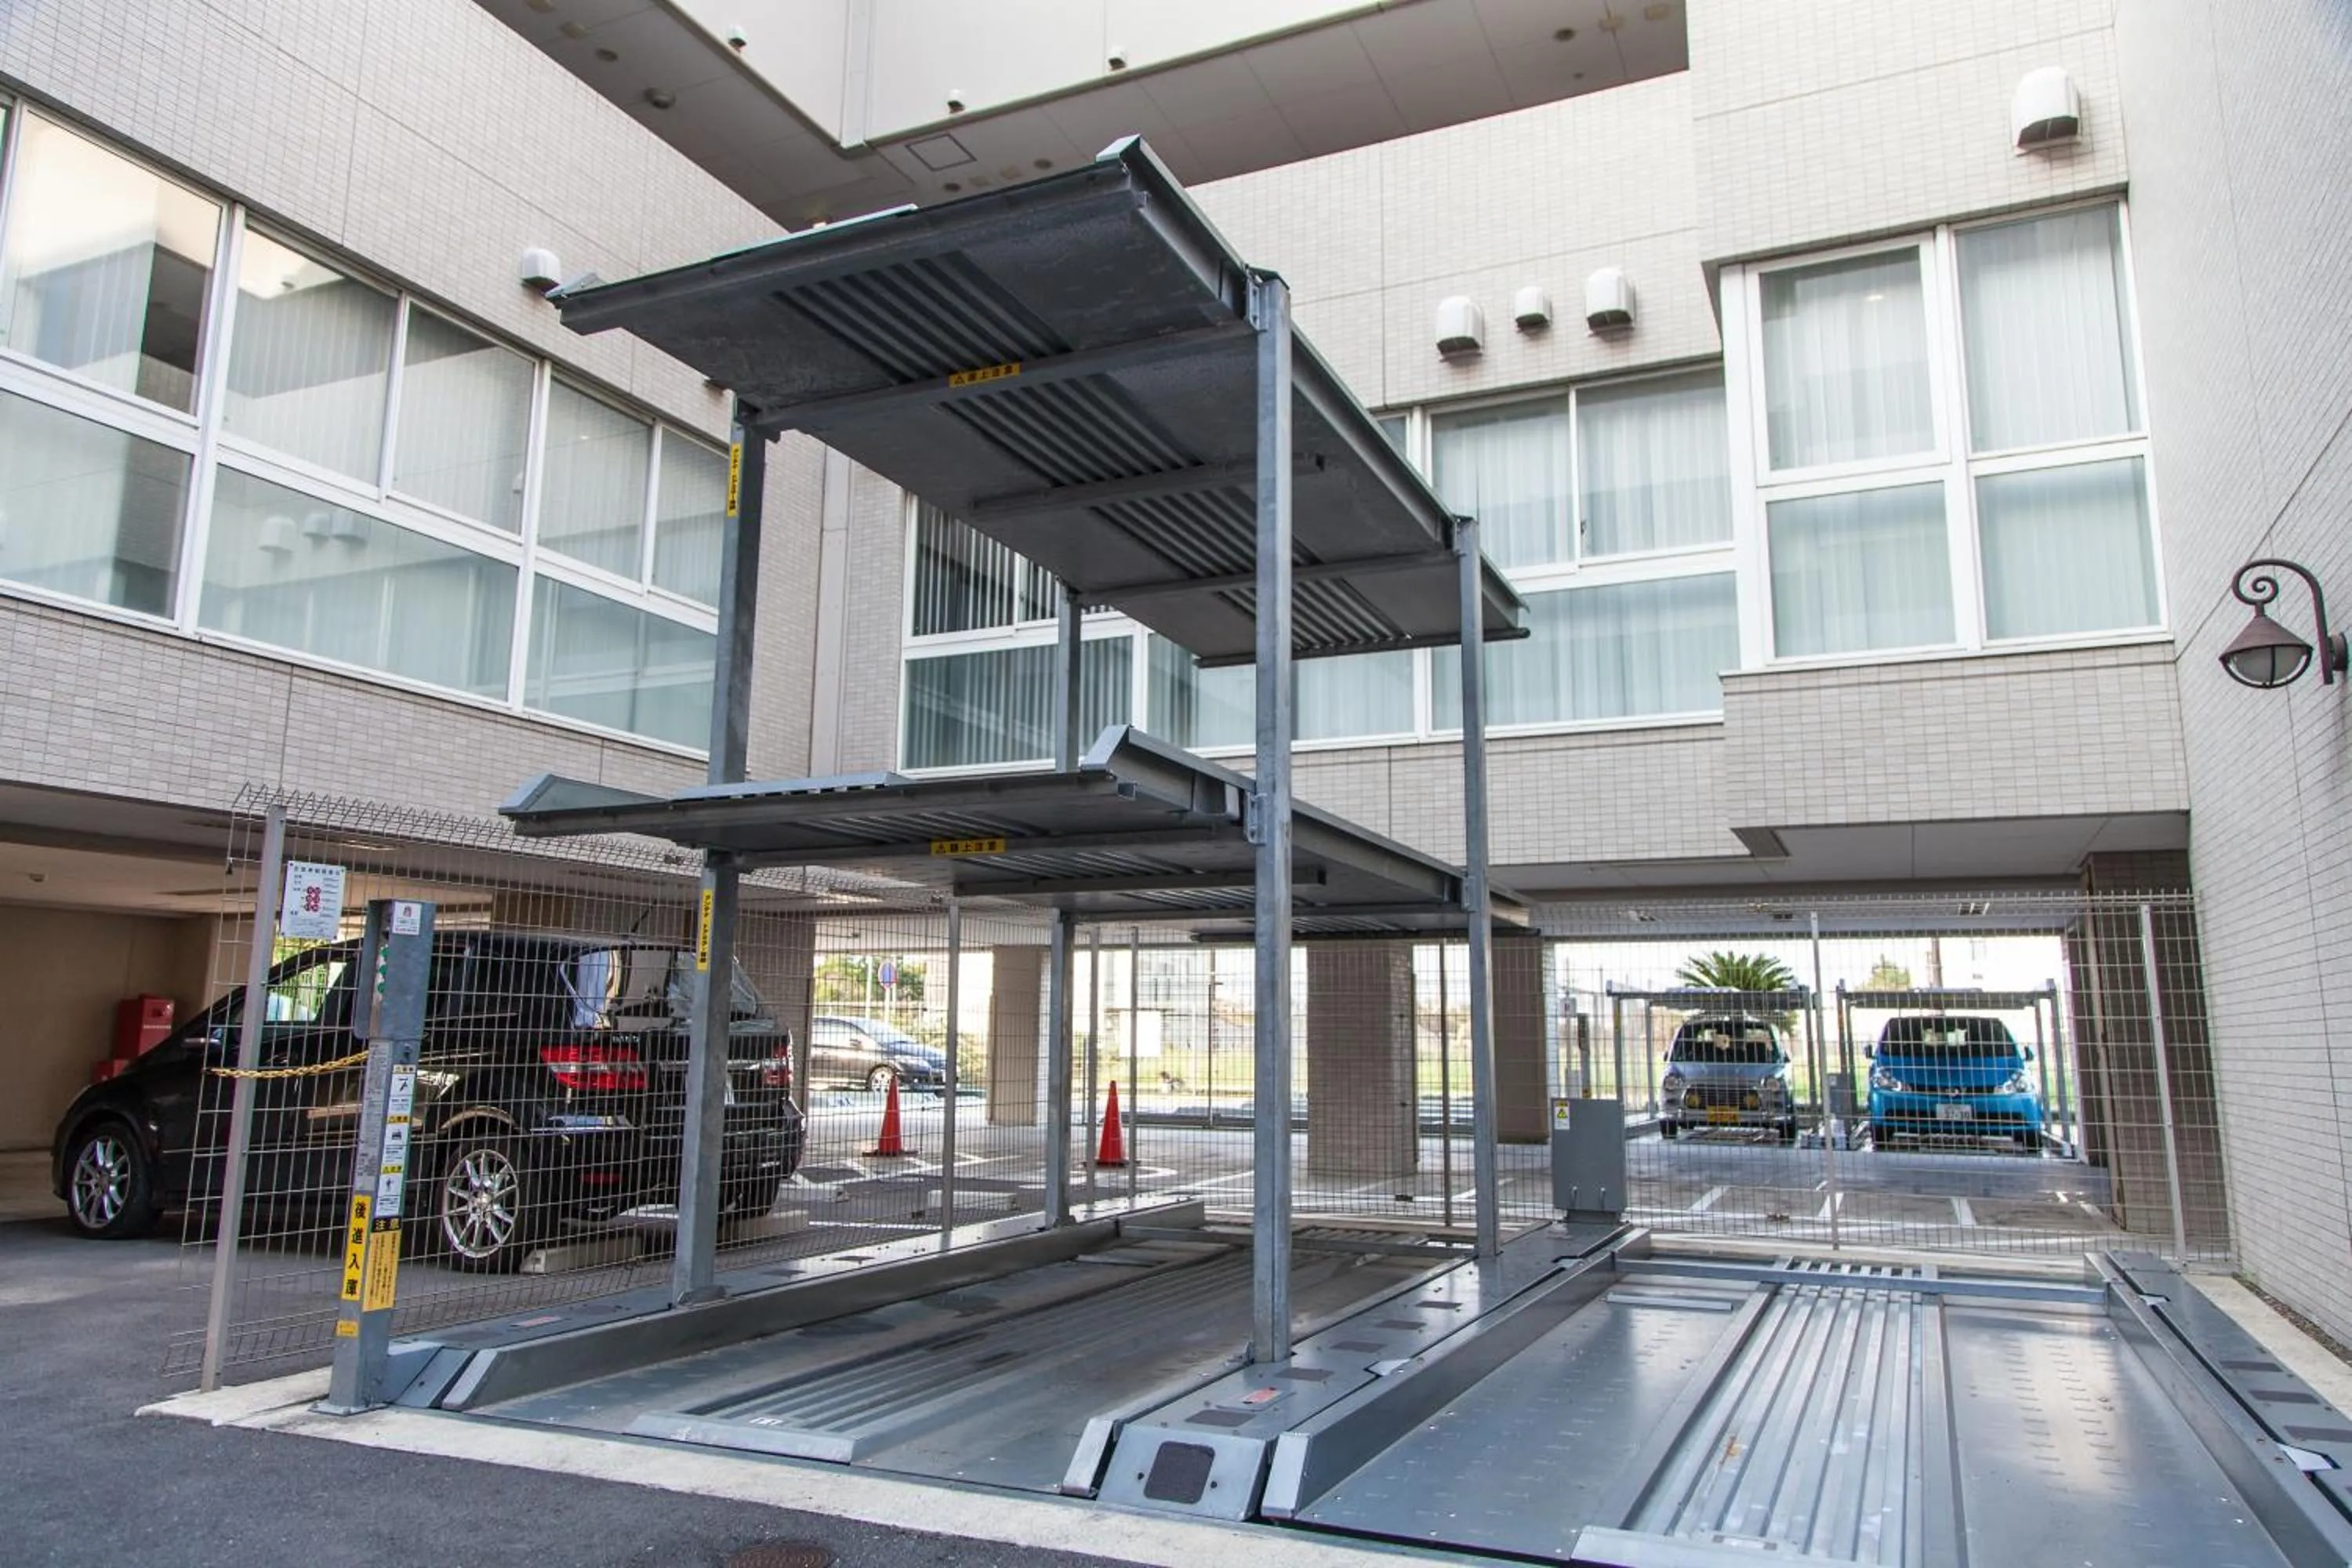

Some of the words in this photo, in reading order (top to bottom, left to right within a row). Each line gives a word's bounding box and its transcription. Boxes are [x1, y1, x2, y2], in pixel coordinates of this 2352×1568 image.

[346, 1202, 366, 1295] 後進入庫
[375, 1218, 400, 1231] 注意
